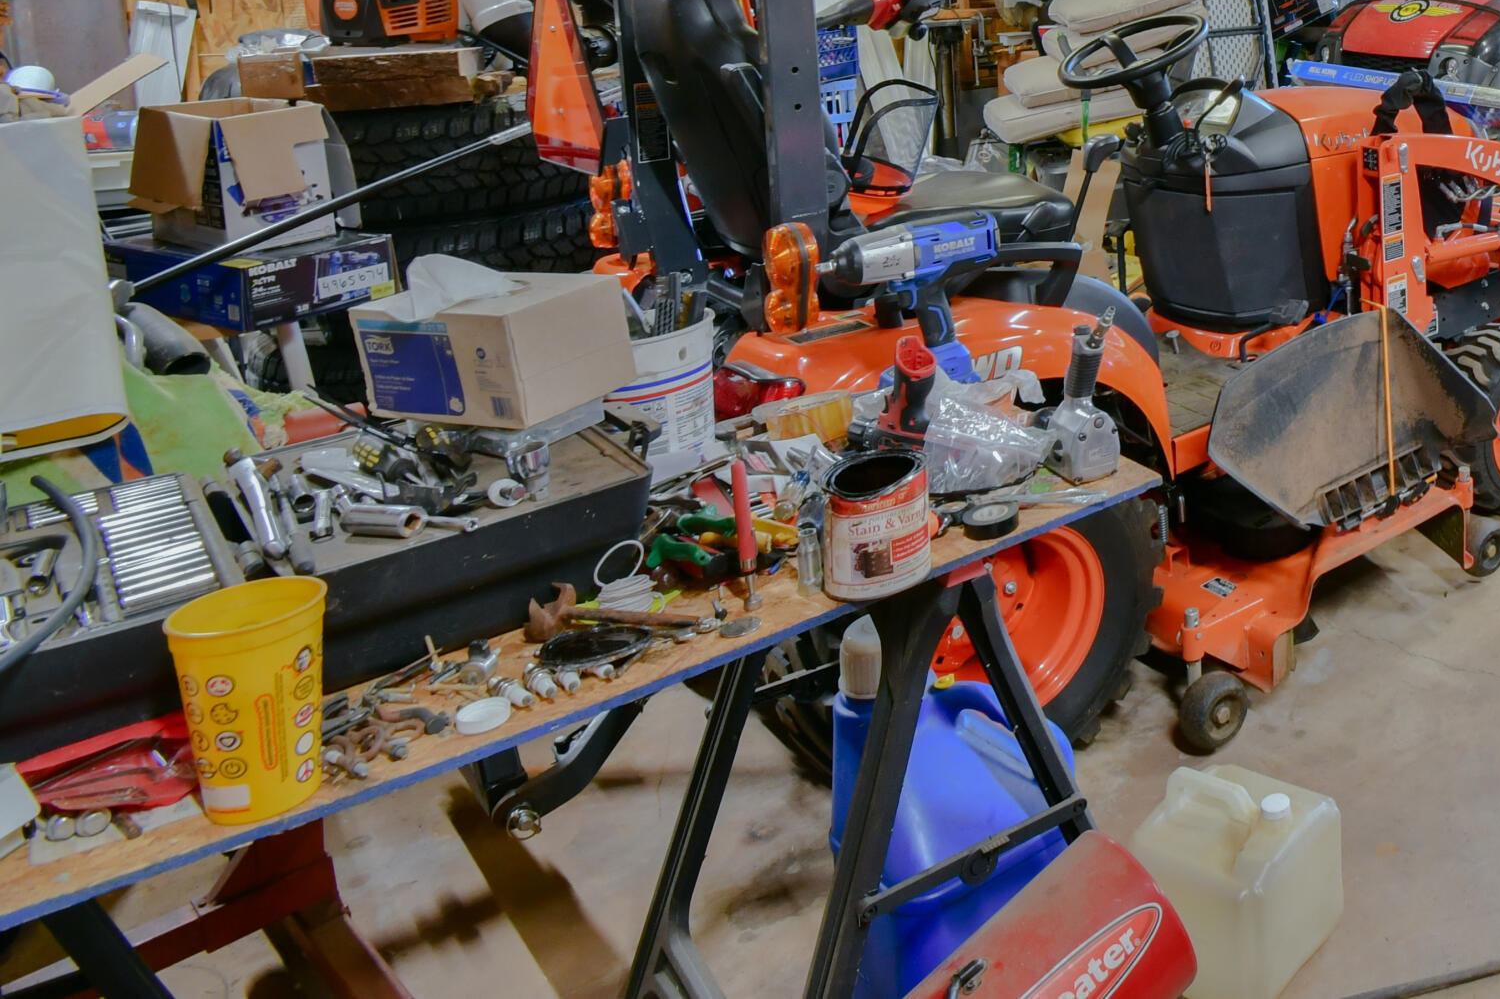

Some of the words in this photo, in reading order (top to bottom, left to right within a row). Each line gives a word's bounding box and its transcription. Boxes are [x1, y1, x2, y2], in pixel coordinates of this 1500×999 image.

[932, 236, 976, 253] KOBALT
[247, 257, 298, 278] KOBALT
[366, 340, 393, 352] TORK
[847, 522, 881, 537] Stain
[884, 518, 896, 530] &
